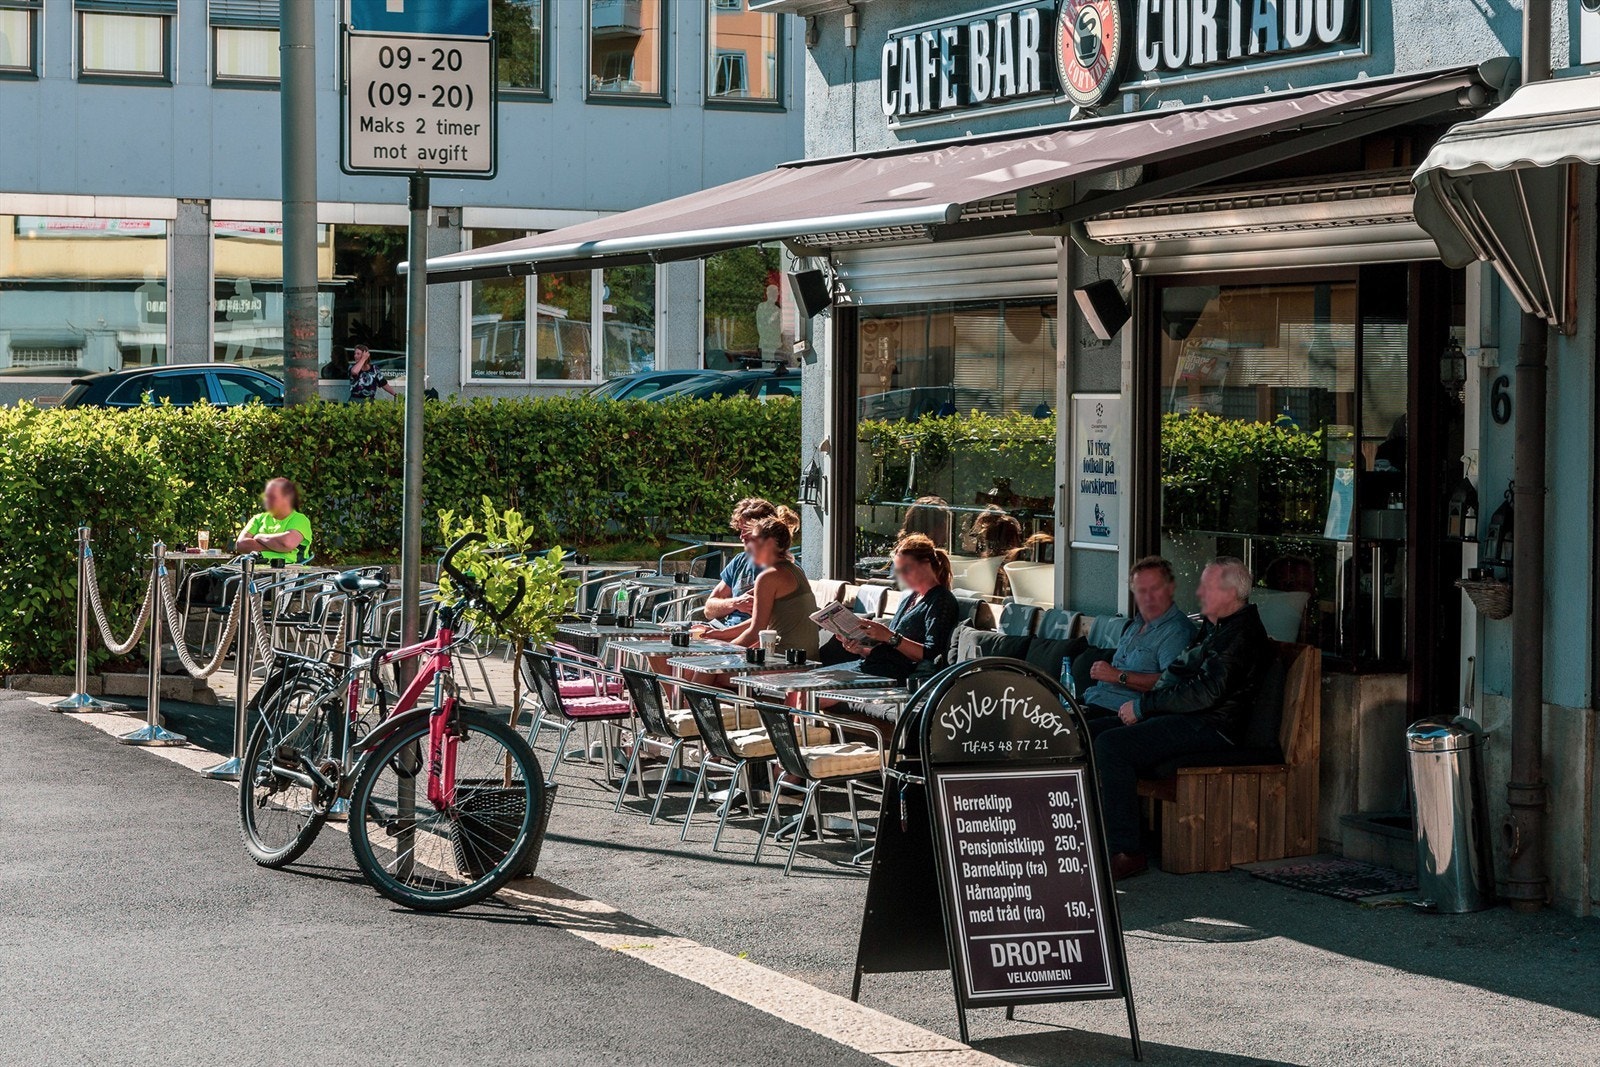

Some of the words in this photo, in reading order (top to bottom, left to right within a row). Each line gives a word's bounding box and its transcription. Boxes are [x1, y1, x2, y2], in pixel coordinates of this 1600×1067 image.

[379, 46, 462, 71] 09-20
[881, 26, 959, 115] CAFE
[969, 8, 1041, 103] BAR
[1068, 53, 1108, 89] CORTADO
[368, 81, 473, 111] (09-20)
[360, 116, 405, 134] Maks
[416, 118, 426, 134] 2
[437, 119, 480, 136] timer
[374, 144, 407, 159] mot
[417, 145, 468, 164] avgift
[1491, 375, 1512, 425] 6
[1087, 440, 1094, 456] Vi
[1095, 440, 1111, 456] viser
[1083, 457, 1103, 474] fotball
[1105, 456, 1115, 476] på
[1080, 479, 1117, 496] storskjerm!
[940, 690, 998, 740] Style
[1000, 686, 1071, 736] frisør
[998, 741, 1013, 752] 48
[1016, 740, 1031, 751] 77
[1034, 739, 1049, 750] 21
[953, 794, 1013, 813] Herreklipp
[1048, 791, 1078, 809] 300,-
[956, 816, 1017, 835] Dameklipp
[1051, 813, 1081, 830] 300,-
[959, 837, 1045, 858] Pensjonistklipp
[1054, 835, 1085, 852] 250,-
[962, 861, 1024, 879] Barneklipp
[1026, 860, 1048, 878] (fra)
[1058, 857, 1088, 875] 200,-
[965, 883, 1032, 902] Hårnapping
[969, 906, 995, 923] med
[996, 904, 1020, 922] tråd
[1023, 905, 1046, 923] (fra)
[1064, 901, 1095, 918] 150,-
[990, 939, 1082, 968] DROP-IN
[1007, 969, 1072, 984] VELKOMMEN!
